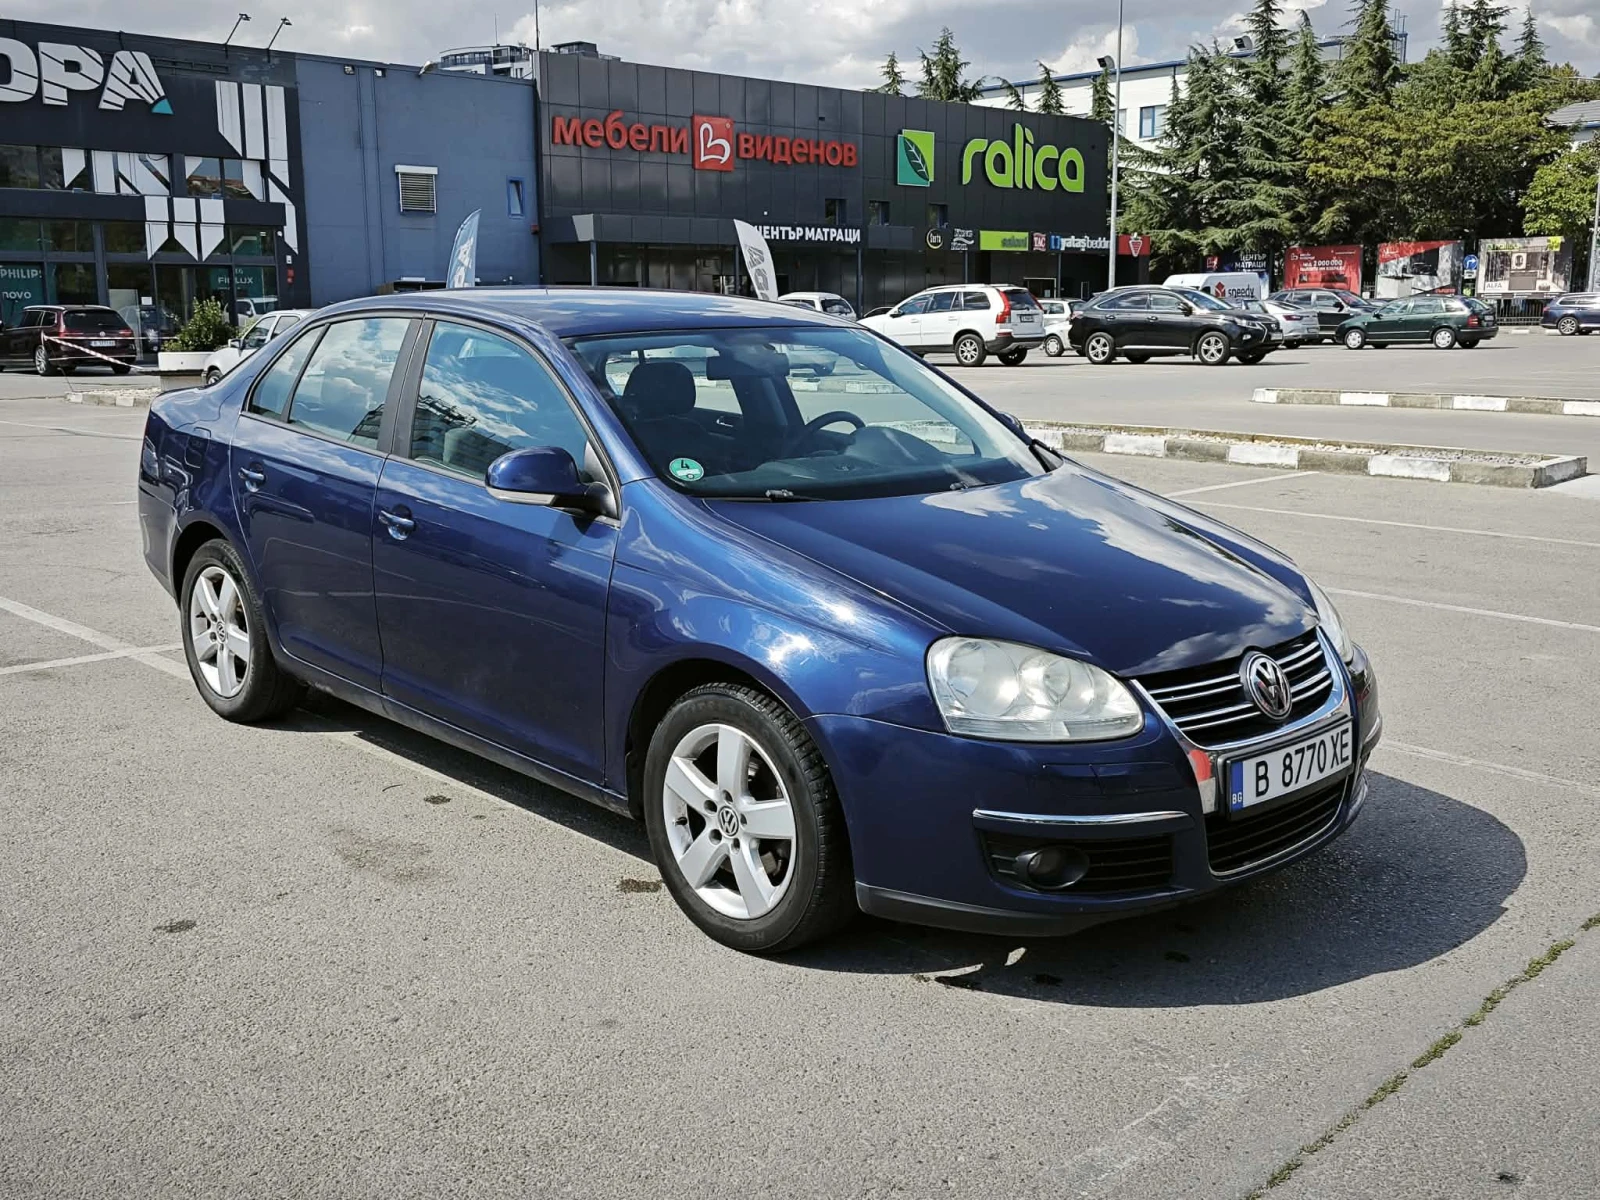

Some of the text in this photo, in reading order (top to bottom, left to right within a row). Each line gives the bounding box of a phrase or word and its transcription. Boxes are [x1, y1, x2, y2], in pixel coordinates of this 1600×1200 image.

[552, 109, 689, 154] мебели
[737, 132, 858, 167] виденов
[962, 123, 1085, 193] ralica
[804, 227, 860, 244] МАТРАЦИ
[1228, 284, 1254, 298] speedy
[681, 459, 690, 470] 4
[1255, 727, 1349, 797] B 8770 XE
[1232, 792, 1243, 804] BG
